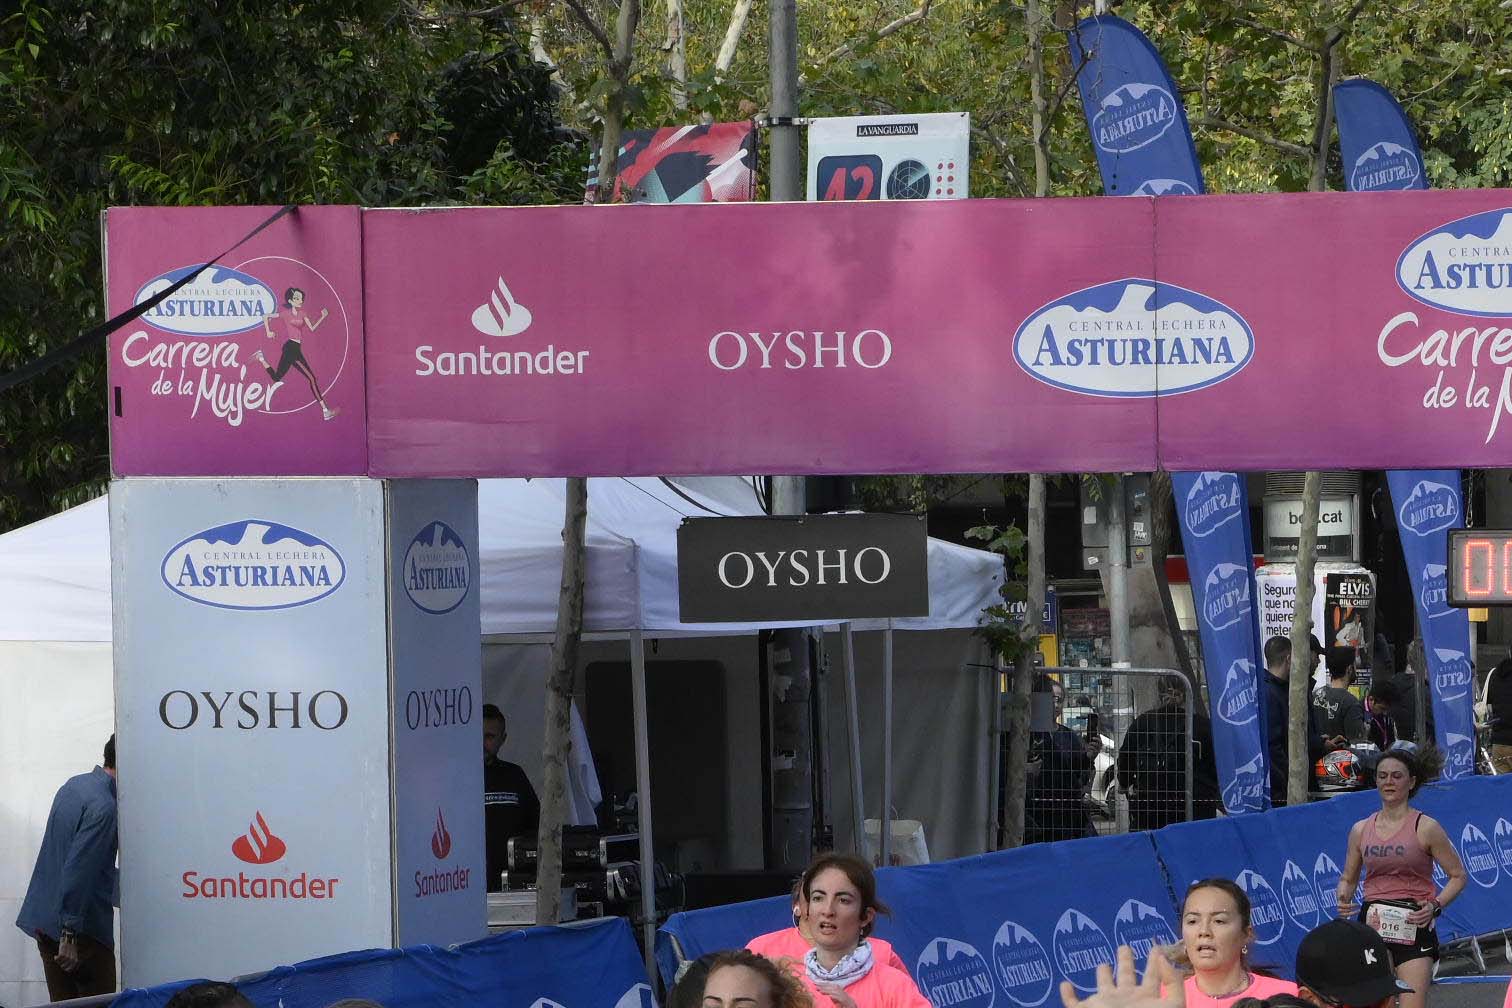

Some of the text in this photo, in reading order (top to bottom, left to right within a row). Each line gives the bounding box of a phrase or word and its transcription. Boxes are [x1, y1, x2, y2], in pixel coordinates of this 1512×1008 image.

[869, 124, 918, 135] VANGUARDIA
[171, 288, 211, 297] ENTRAL
[1069, 319, 1227, 332] CENTRAL LECHERA
[121, 330, 240, 368] Carrera
[415, 344, 589, 377] Santander
[708, 329, 892, 370] OYSHO
[1032, 324, 1236, 367] ASTURIANA
[151, 369, 194, 396] de la
[191, 365, 284, 427] Mujer
[1423, 369, 1490, 409] de la
[1289, 510, 1343, 525] b.cat
[176, 553, 332, 588] ASTURIANA
[204, 550, 326, 562] CENTRAL LECHERA
[717, 547, 891, 589] OYSHO
[408, 559, 467, 591] ASTURIANA
[1339, 582, 1370, 596] ELVIS
[1265, 599, 1281, 611] que
[159, 690, 349, 731] OYSHO
[405, 685, 473, 731] OYSHO
[182, 871, 339, 899] Santander
[415, 865, 471, 899] Santander
[1381, 922, 1400, 931] 016
[1364, 948, 1378, 965] K
